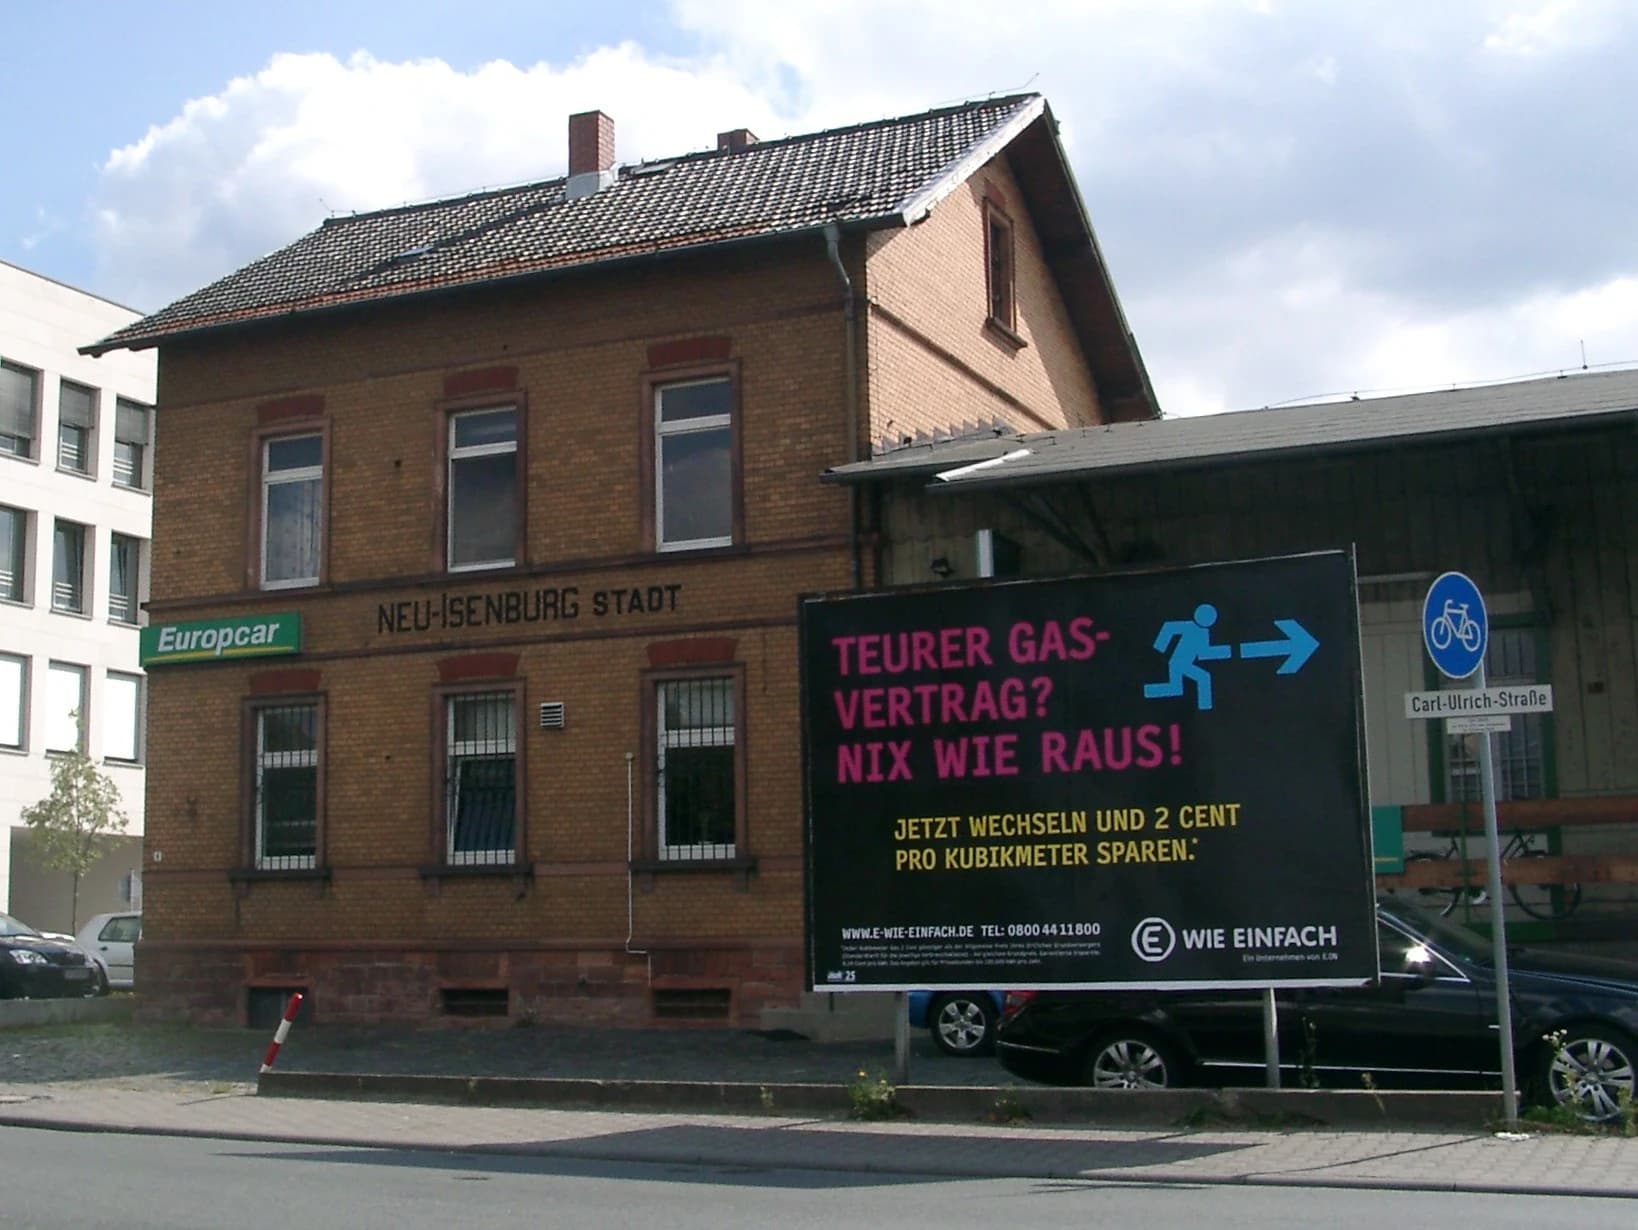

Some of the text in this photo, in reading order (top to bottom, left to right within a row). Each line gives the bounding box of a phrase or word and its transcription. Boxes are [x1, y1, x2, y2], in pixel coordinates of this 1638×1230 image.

[592, 584, 682, 617] STADT
[157, 621, 280, 656] Europcar
[832, 617, 1110, 675] TEURER GAS-
[833, 677, 1054, 730] VERTRAG?
[1412, 689, 1547, 713] Carl-Ulrich-Straße
[837, 724, 1183, 783] NIX WIE RAUS!
[894, 803, 1241, 841] JETZT WECHSELN UND 2 CENT
[895, 849, 937, 871] PRO
[945, 842, 1088, 869] KUBIKMETER
[842, 925, 974, 939] WWW.E-WIE-EINFACH.DE
[981, 924, 1005, 936] TEL:
[1008, 923, 1040, 937] 0800
[1182, 929, 1225, 949] WIE
[1233, 926, 1337, 948] EINFACH
